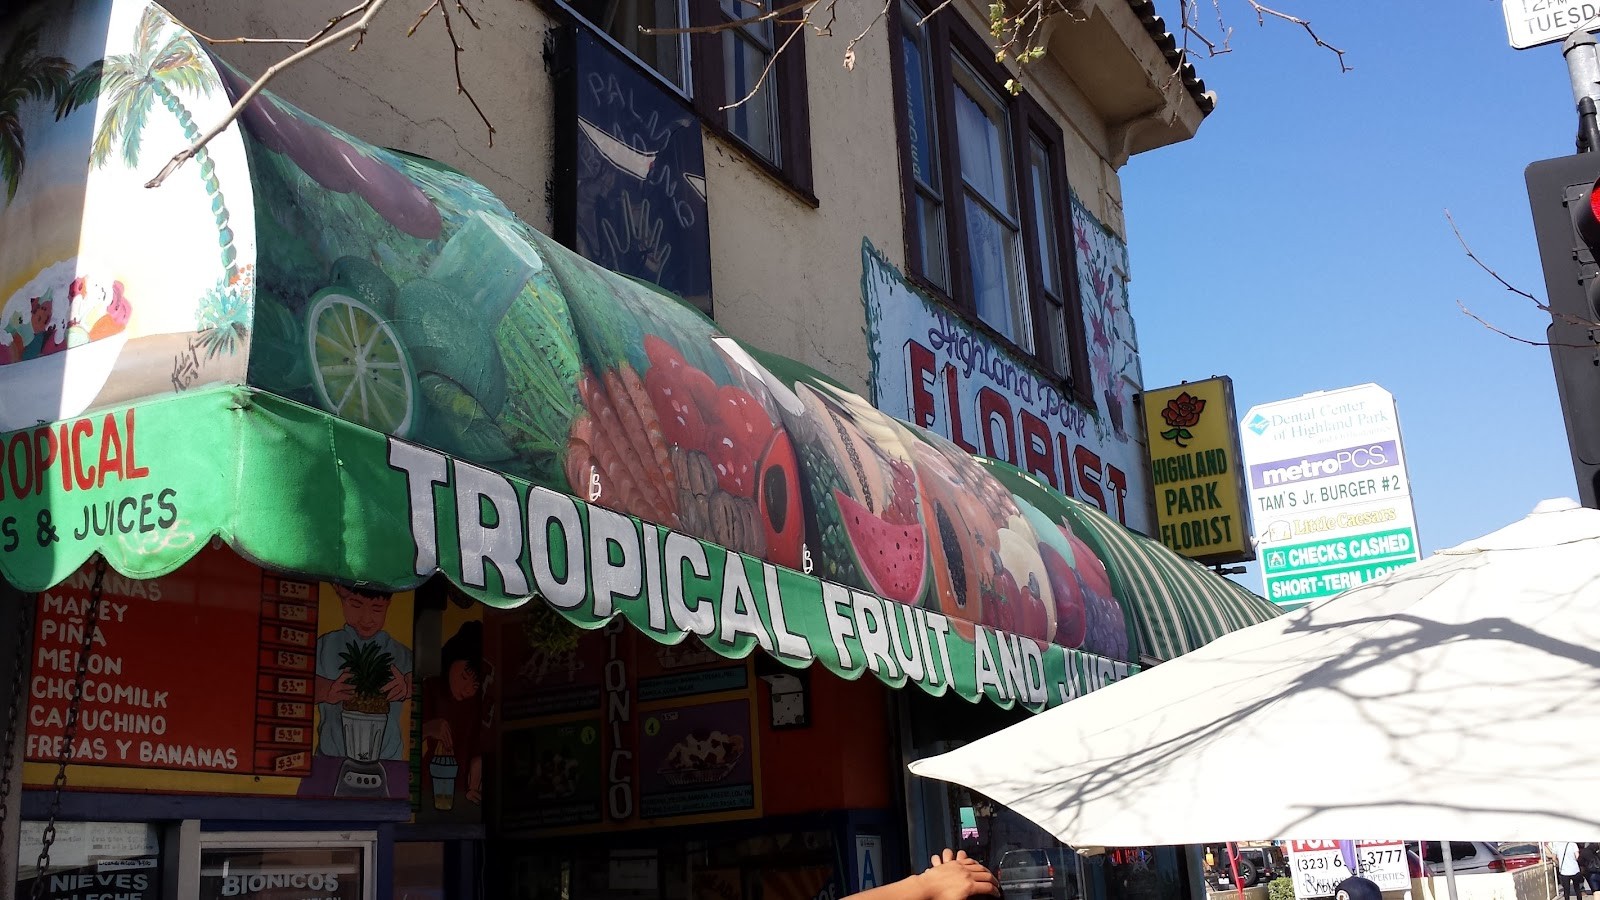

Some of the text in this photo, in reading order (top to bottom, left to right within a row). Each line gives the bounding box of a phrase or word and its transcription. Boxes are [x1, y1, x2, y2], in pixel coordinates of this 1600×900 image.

[1522, 0, 1567, 13] 12
[1524, 3, 1600, 34] TUESD
[928, 306, 1088, 439] Highland Park
[1271, 400, 1366, 427] Dental Center
[1273, 429, 1287, 441] of
[1290, 415, 1353, 439] Highland
[1357, 409, 1389, 425] Park
[903, 337, 1128, 528] FLORIST
[0, 408, 149, 500] OPICAL
[1152, 448, 1228, 486] HIGHLAND
[1164, 481, 1222, 516] PARK
[1258, 475, 1401, 512] TAM'S Jr. BURGER #2
[74, 488, 177, 541] JUICES
[1292, 507, 1397, 536] Little Caesars
[1161, 515, 1232, 551] FLORIST
[1288, 533, 1410, 567] CHECKS CASHED
[387, 436, 816, 663] TROPICAL
[819, 579, 957, 691] FRUIT
[974, 624, 1050, 706] AND
[1271, 563, 1408, 598] SHORT-TERM LOA
[41, 616, 107, 648] PIÑA
[38, 647, 122, 675] MELON
[31, 675, 169, 708] CHOCOMILK
[26, 734, 238, 769] FRESAS Y BANANAS
[863, 850, 877, 890] A
[1297, 849, 1402, 872] (323) 6-3777
[1359, 872, 1404, 882] OPERTIES
[50, 873, 149, 893] NIEVES
[222, 872, 339, 897] BIONICOS
